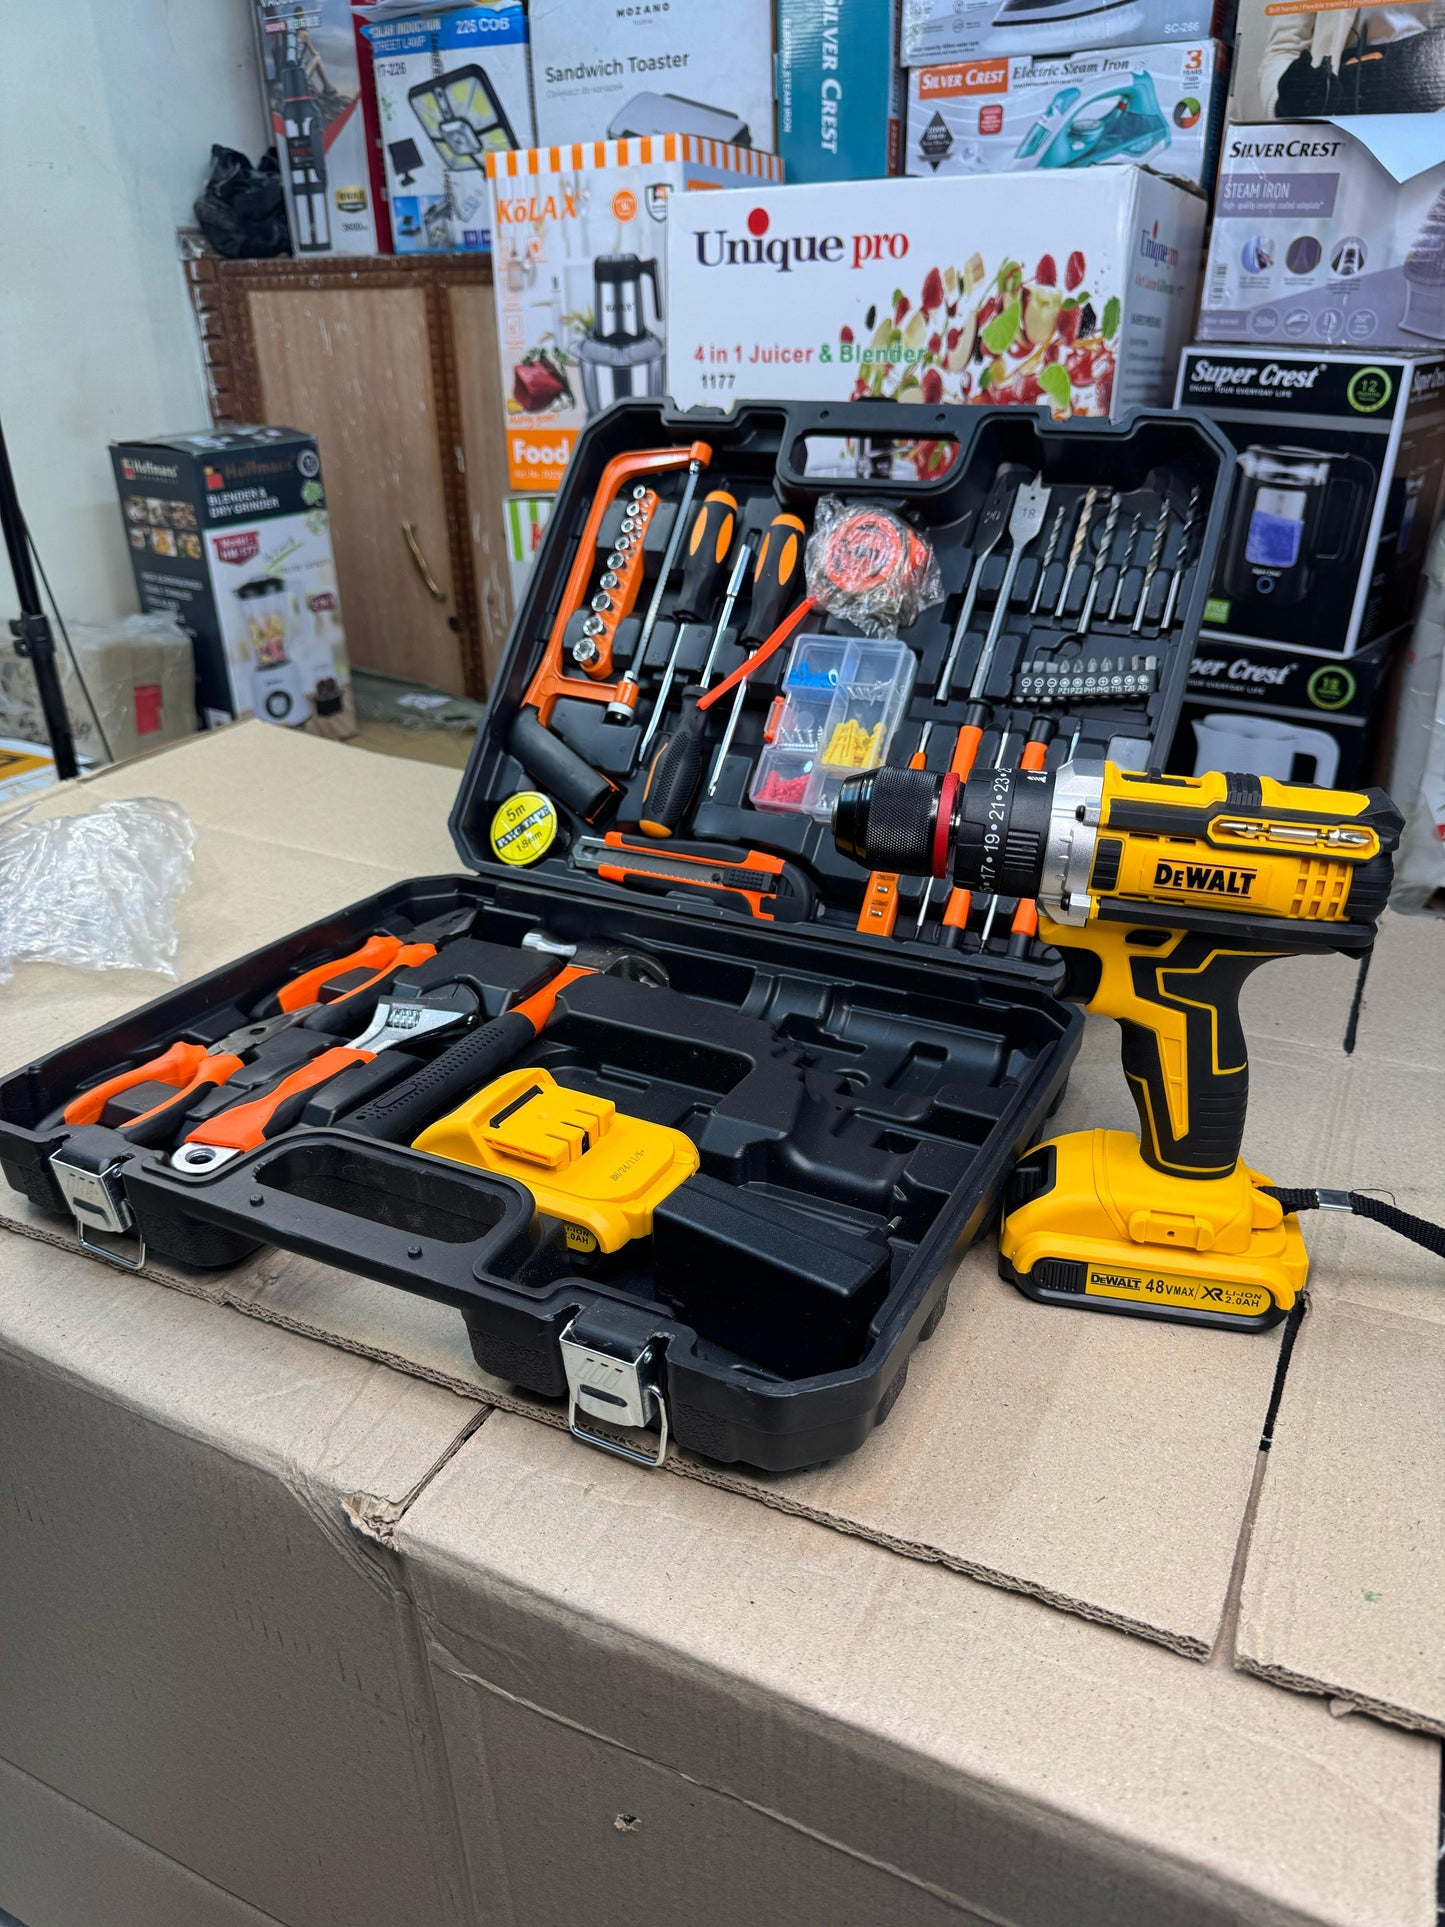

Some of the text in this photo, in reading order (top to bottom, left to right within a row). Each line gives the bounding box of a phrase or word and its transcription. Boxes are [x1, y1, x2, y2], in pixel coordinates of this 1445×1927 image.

[616, 2, 671, 18] MOZANO
[455, 18, 510, 34] 226 COB
[545, 53, 690, 82] Sandwich Toaster
[1185, 50, 1203, 69] 3
[1012, 58, 1130, 80] Electric Steam Iron
[921, 72, 962, 90] SILVER
[965, 68, 1006, 86] CREST
[784, 71, 792, 106] STEAM
[782, 107, 791, 133] IRON
[820, 78, 843, 154] CREST
[1224, 182, 1291, 199] STEAM IRON
[692, 207, 910, 272] Unique pro
[694, 344, 926, 363] 4 in 1 Juicer & Blender
[701, 372, 736, 389] 1177
[1191, 360, 1319, 390] Super Crest
[1361, 380, 1378, 393] 12
[513, 436, 570, 465] Food
[1228, 658, 1291, 685] Crest
[1083, 686, 1096, 694] PH1
[993, 777, 1010, 793] 23
[506, 804, 526, 822] 5m
[989, 802, 1006, 821] 21
[984, 834, 1000, 850] 19
[981, 865, 996, 879] 17
[1200, 1286, 1224, 1302] XR
[1225, 1290, 1262, 1300] LI-ION
[1225, 1296, 1259, 1307] 2.0AH
